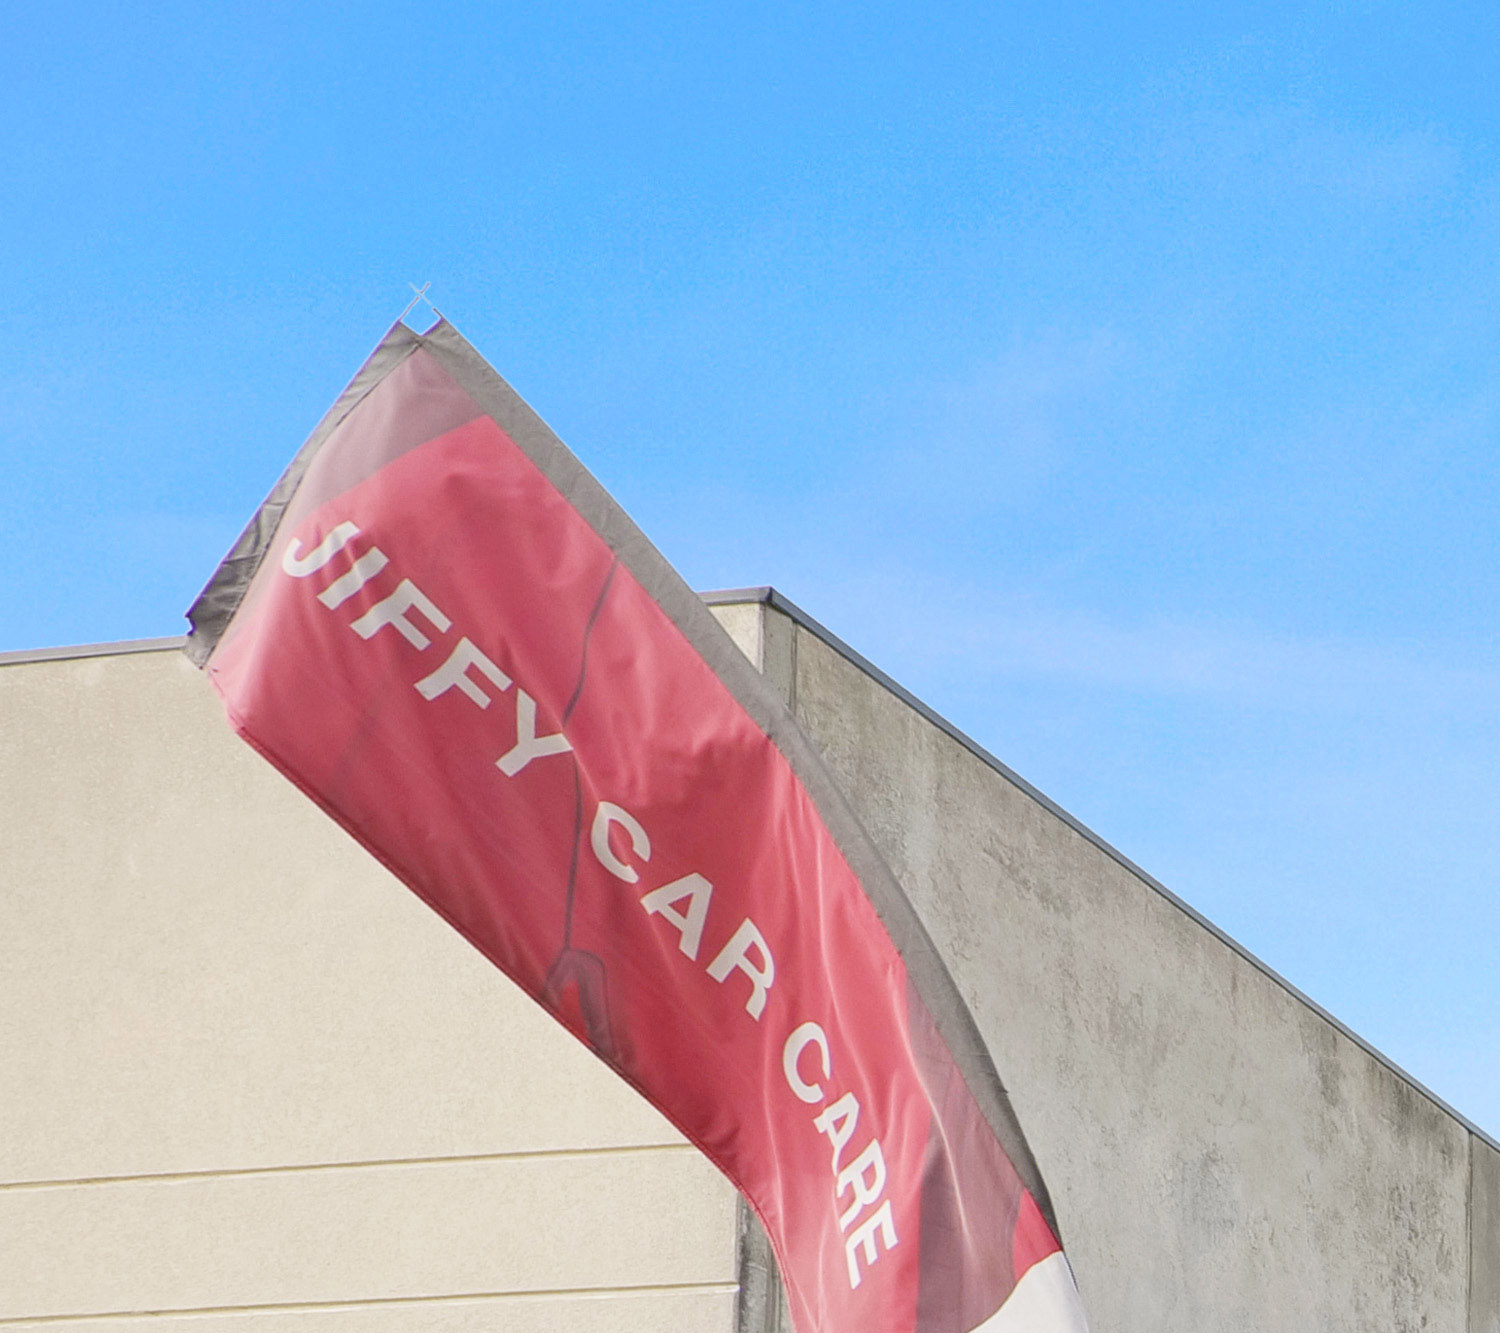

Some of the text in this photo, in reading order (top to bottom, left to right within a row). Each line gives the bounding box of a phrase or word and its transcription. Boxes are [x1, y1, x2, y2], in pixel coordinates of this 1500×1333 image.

[281, 519, 899, 1290] JIFFY CAR CARE
